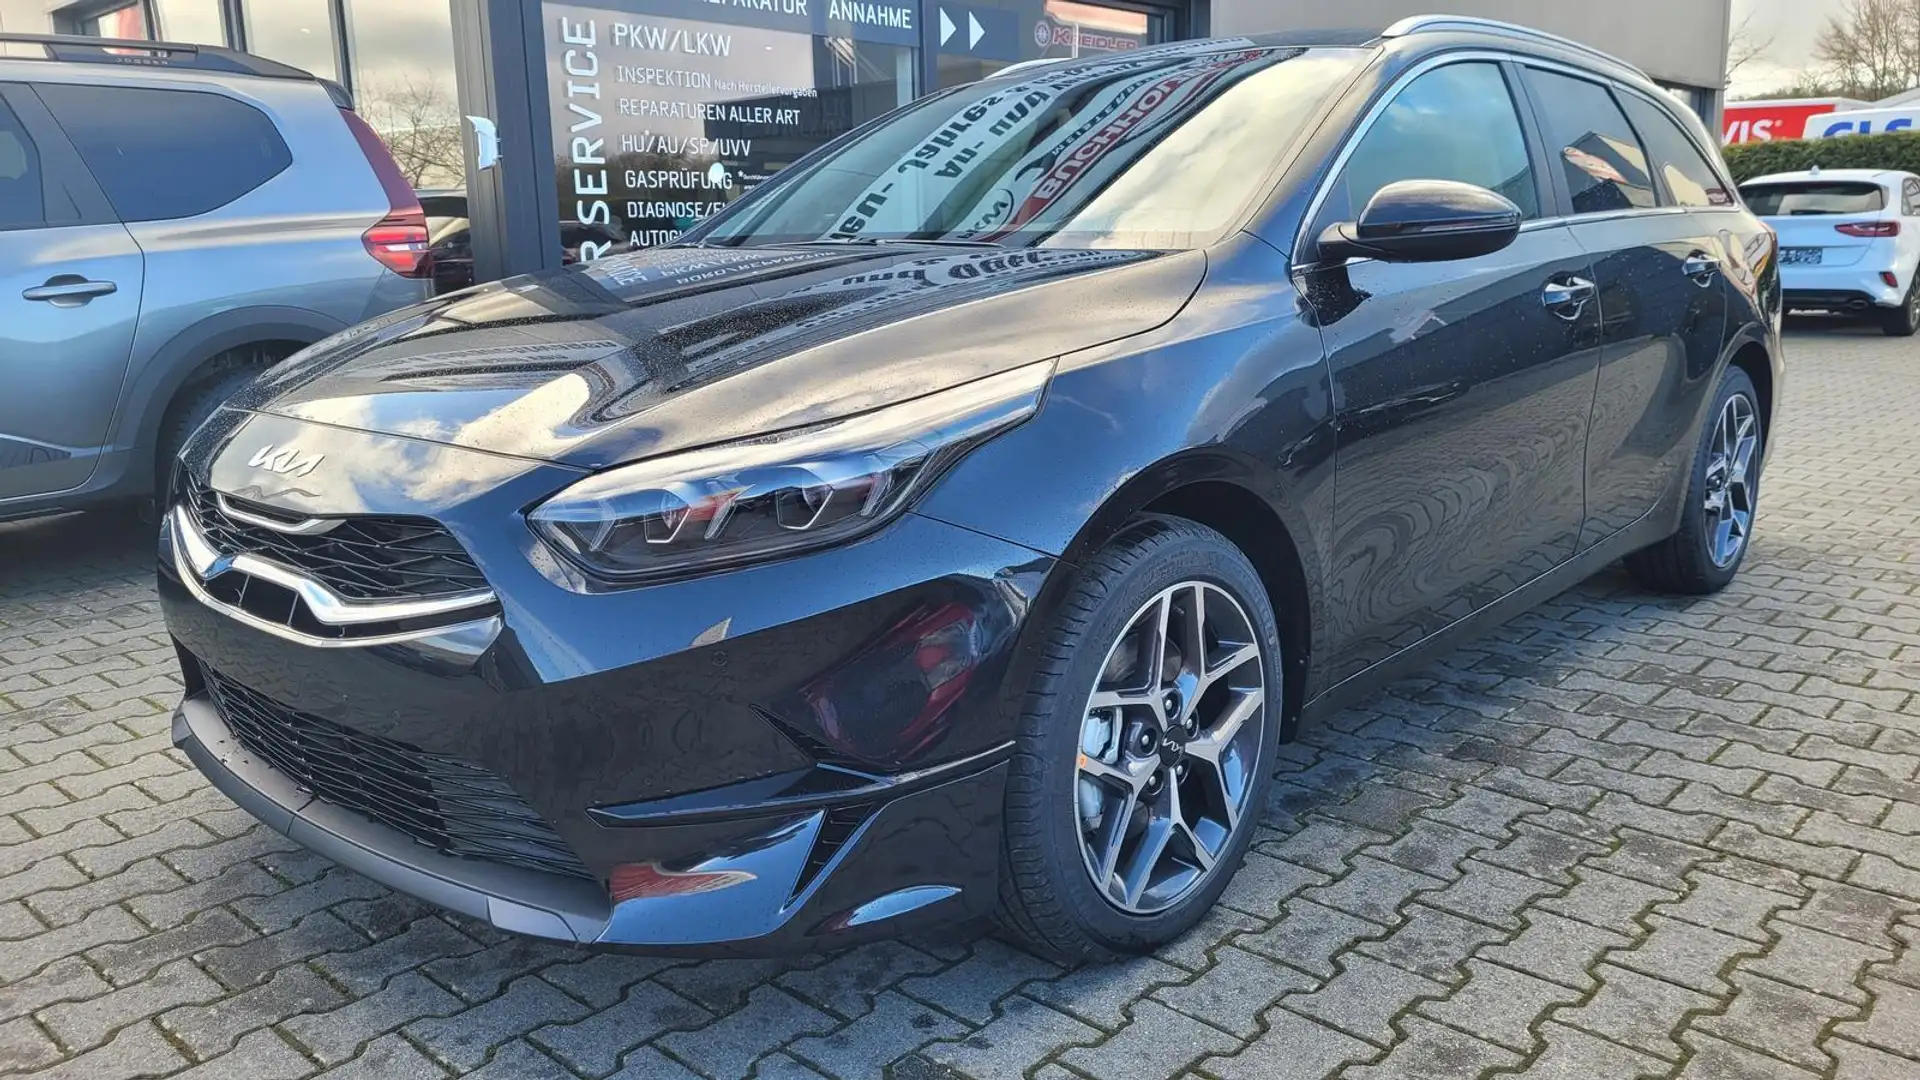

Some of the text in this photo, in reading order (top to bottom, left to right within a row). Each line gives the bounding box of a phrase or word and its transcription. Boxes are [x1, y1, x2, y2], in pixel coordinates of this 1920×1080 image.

[829, 0, 912, 29] ANNAHME
[613, 22, 731, 56] PKW/LKW
[617, 65, 711, 89] INSPEKTION
[562, 16, 610, 225] SERVICE
[619, 98, 801, 125] REPARATUREN ALLER ART
[621, 134, 751, 156] HU/AU/SP/UVV
[625, 167, 732, 189] GASPRÜFUG
[627, 202, 725, 218] DIAGNOSE/E
[630, 230, 683, 246] AUTOG
